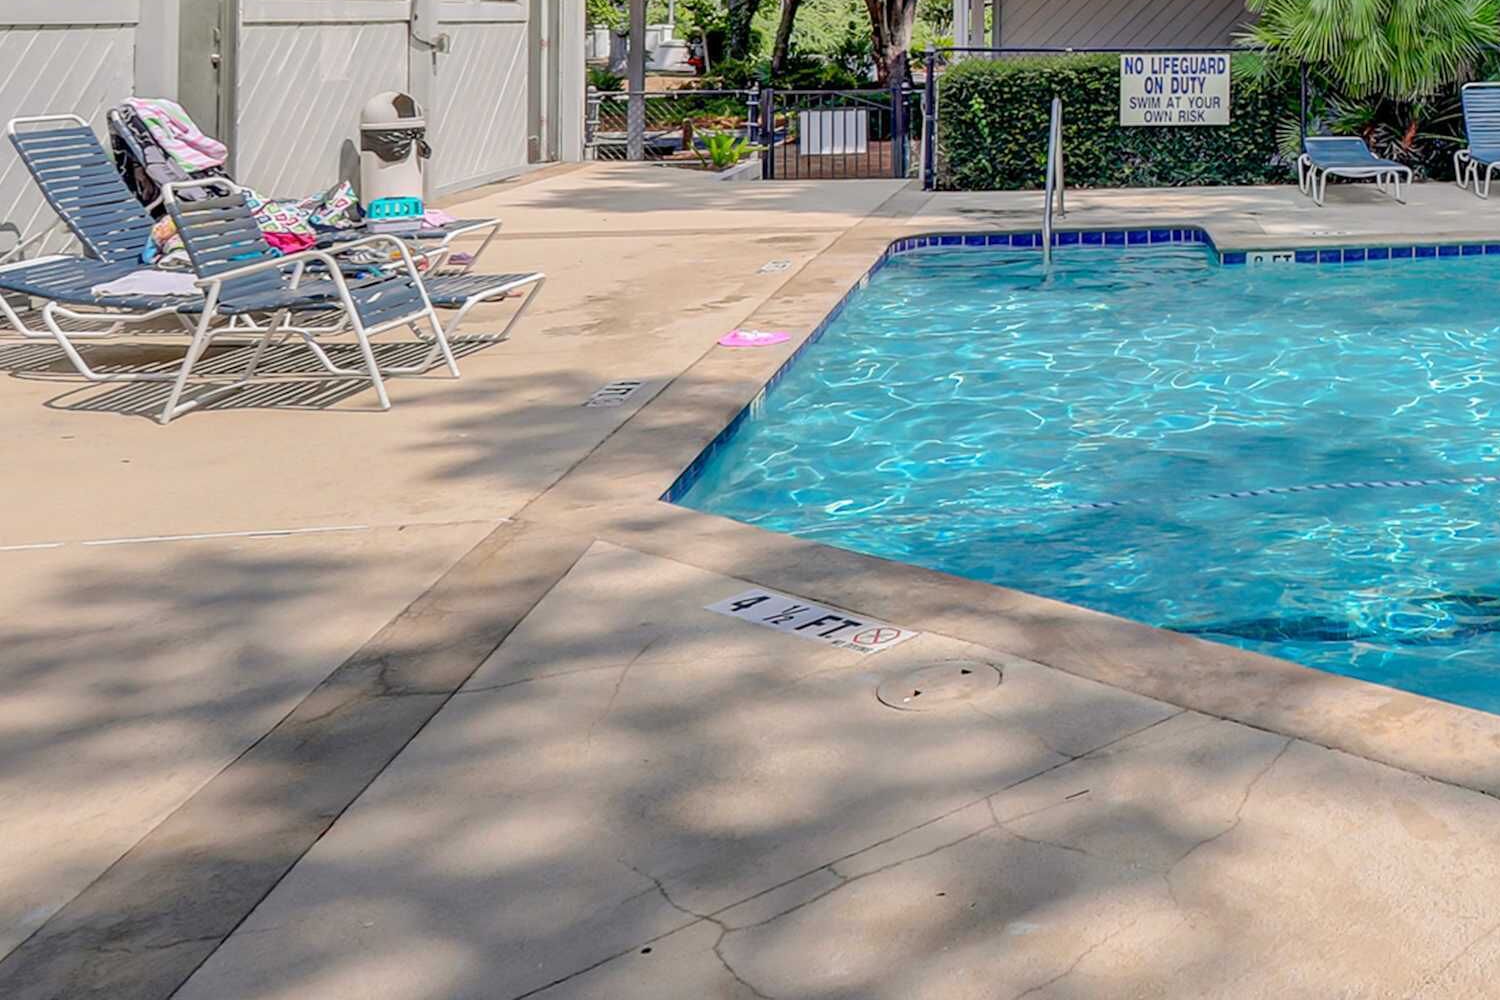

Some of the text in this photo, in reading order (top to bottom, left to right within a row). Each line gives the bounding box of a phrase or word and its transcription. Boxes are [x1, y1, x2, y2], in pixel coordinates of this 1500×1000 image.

[1124, 57, 1226, 75] NO LIFEGUARD
[1144, 76, 1206, 94] ON DUTY
[1129, 96, 1221, 110] SWIM AT YOUR
[1143, 110, 1206, 123] OWN RISK
[730, 595, 771, 612] 4
